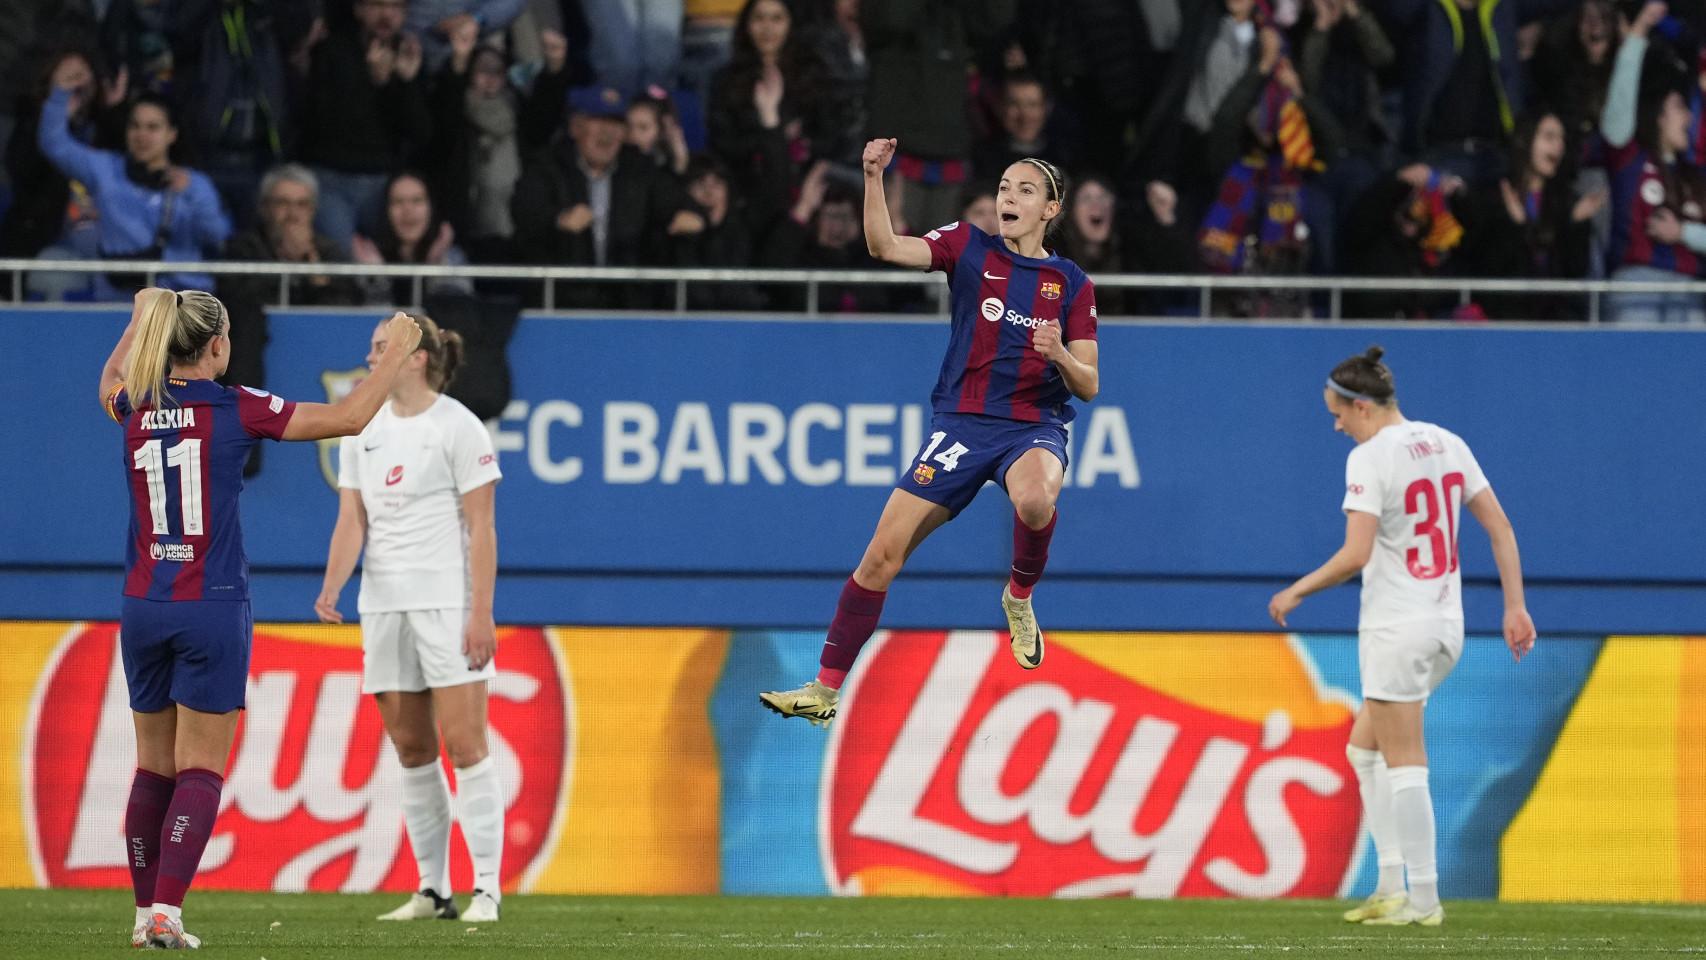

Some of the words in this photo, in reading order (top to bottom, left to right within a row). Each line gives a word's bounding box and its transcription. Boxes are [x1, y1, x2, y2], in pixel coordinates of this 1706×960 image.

[140, 407, 196, 431] ALEXIA
[602, 401, 1141, 488] BARCELA
[918, 430, 970, 473] 14
[133, 438, 204, 536] 11
[1404, 471, 1466, 580] 30
[165, 543, 194, 552] UNHCR
[166, 551, 194, 559] ACNUR
[851, 631, 1344, 898] Lay's
[170, 815, 190, 843] BARÇA
[132, 837, 147, 868] BARÇA
